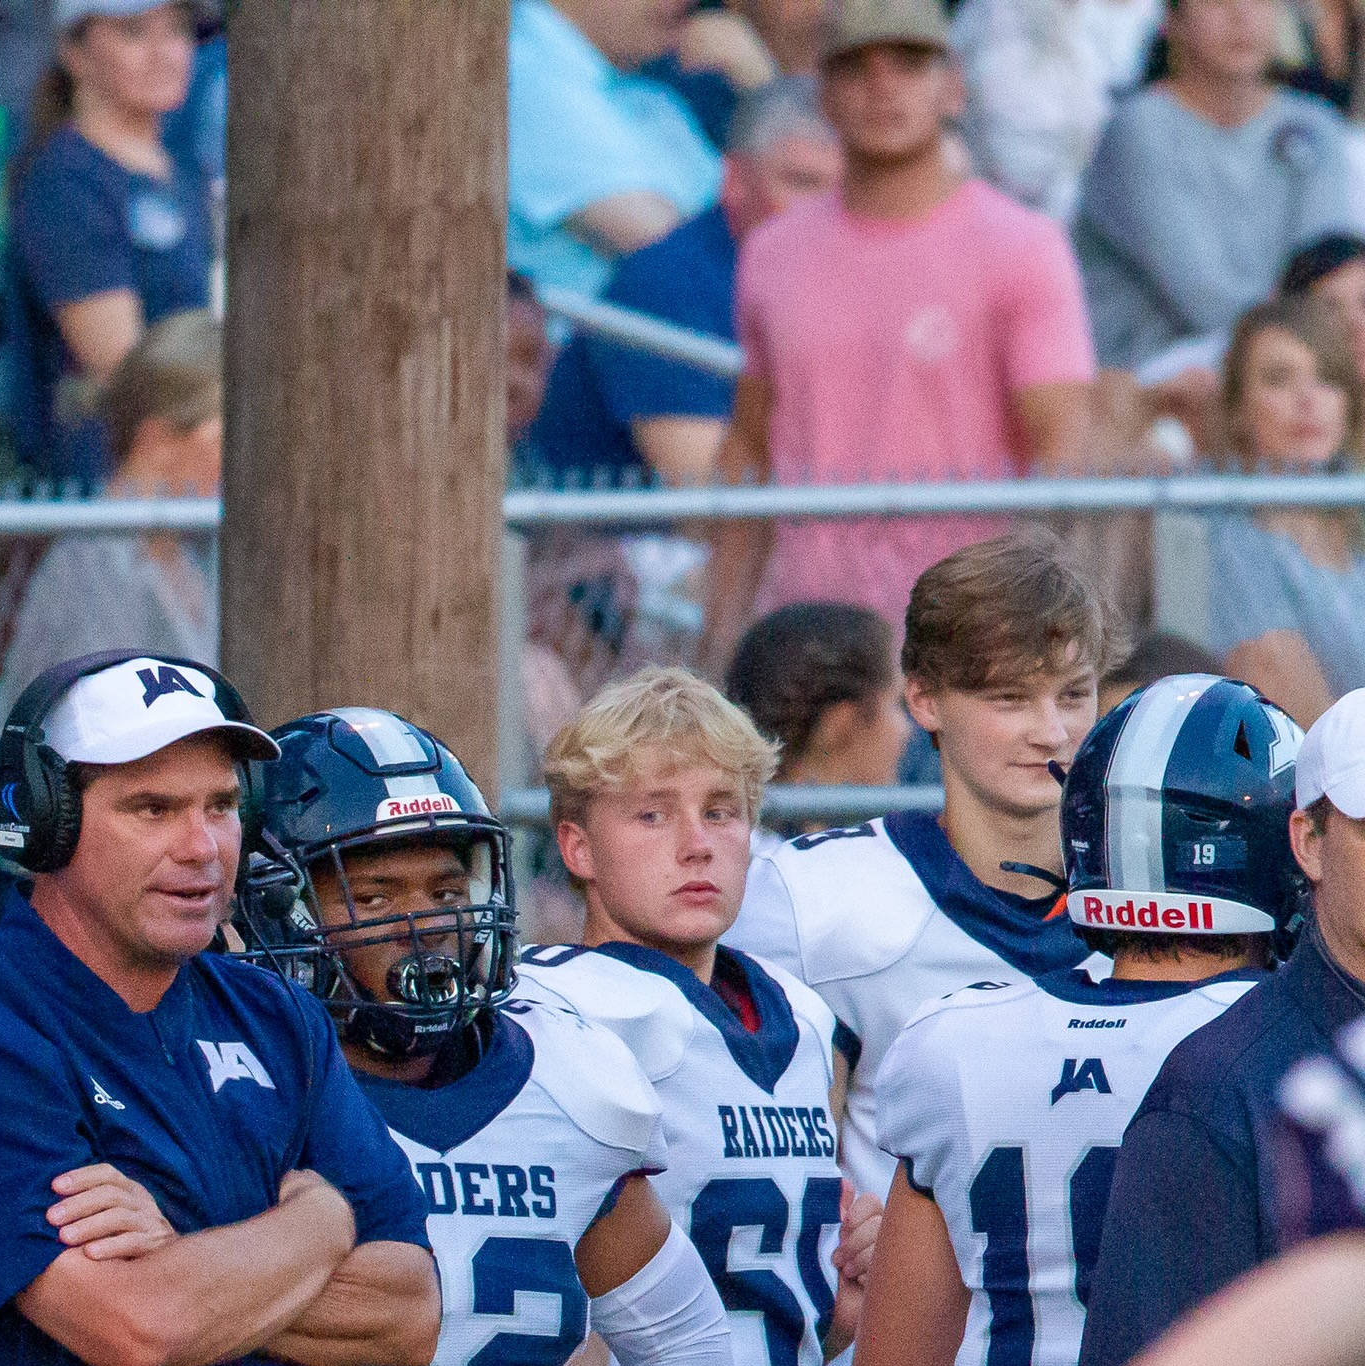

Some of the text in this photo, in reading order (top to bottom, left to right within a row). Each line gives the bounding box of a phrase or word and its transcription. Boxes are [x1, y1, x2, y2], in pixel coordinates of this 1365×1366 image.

[387, 796, 453, 816] Riddell
[1192, 843, 1216, 866] 19
[1083, 895, 1214, 931] Riddell
[1067, 1018, 1127, 1029] Riddell
[722, 1105, 835, 1158] RAIDERS
